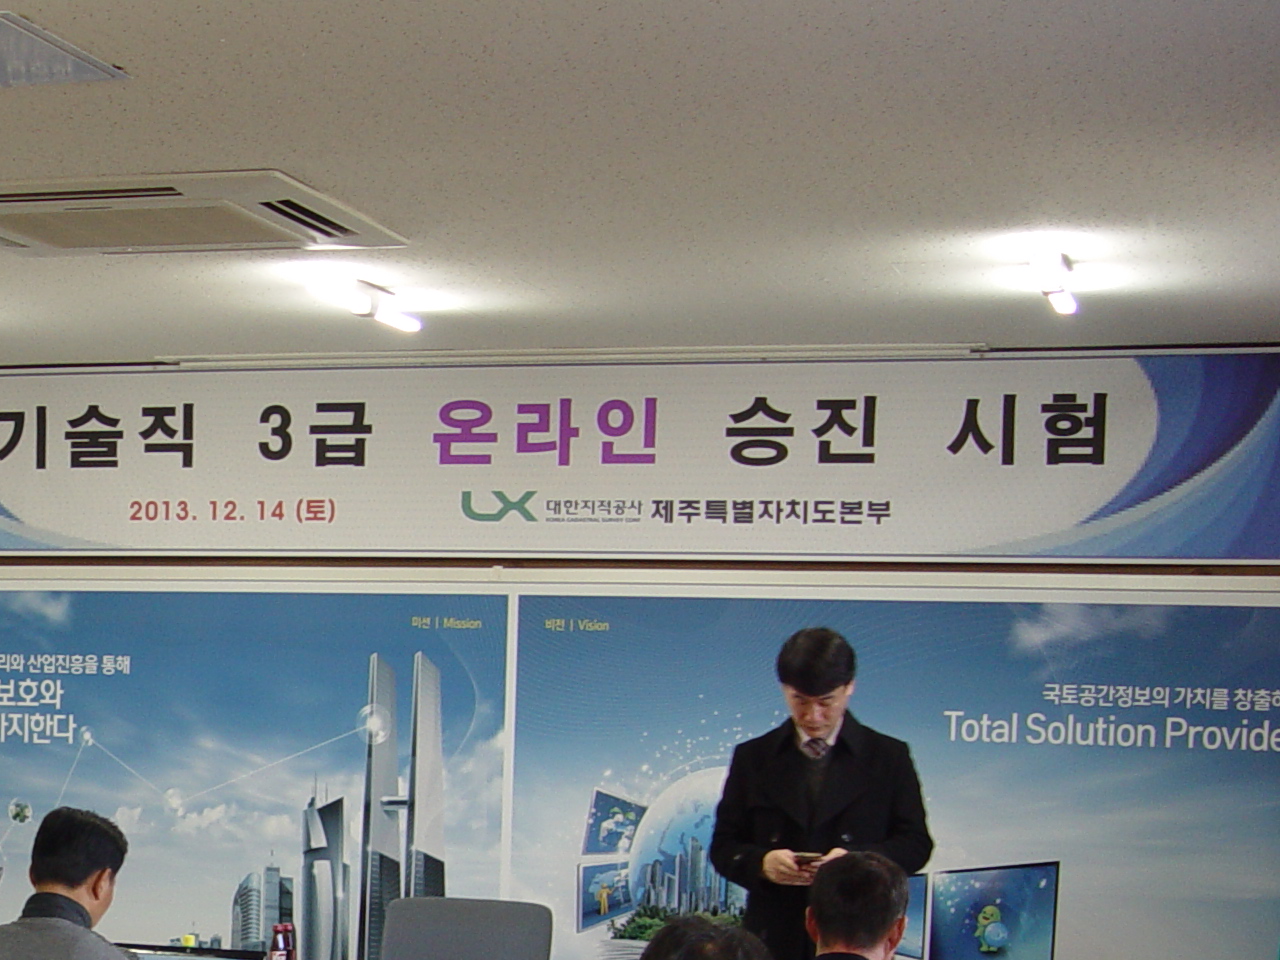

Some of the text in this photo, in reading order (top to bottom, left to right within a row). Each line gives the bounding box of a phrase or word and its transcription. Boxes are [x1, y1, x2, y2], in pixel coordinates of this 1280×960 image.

[258, 402, 374, 469] 3급
[432, 396, 659, 468] 온라인
[724, 394, 879, 468] 승진
[947, 390, 1110, 468] 시험
[129, 498, 337, 525] 2013. 12. 14 (토)
[461, 490, 893, 526] LX 대한지적공사 제주특별자치도본부
[443, 616, 482, 630] Mission
[545, 618, 610, 632] 비전 Vision
[27, 654, 99, 675] 산업진흥을
[101, 654, 131, 676] 통해
[1042, 683, 1170, 709] 국토공간정보의
[1173, 686, 1230, 711] 가치를
[943, 710, 1280, 752] Total Solution Provide
